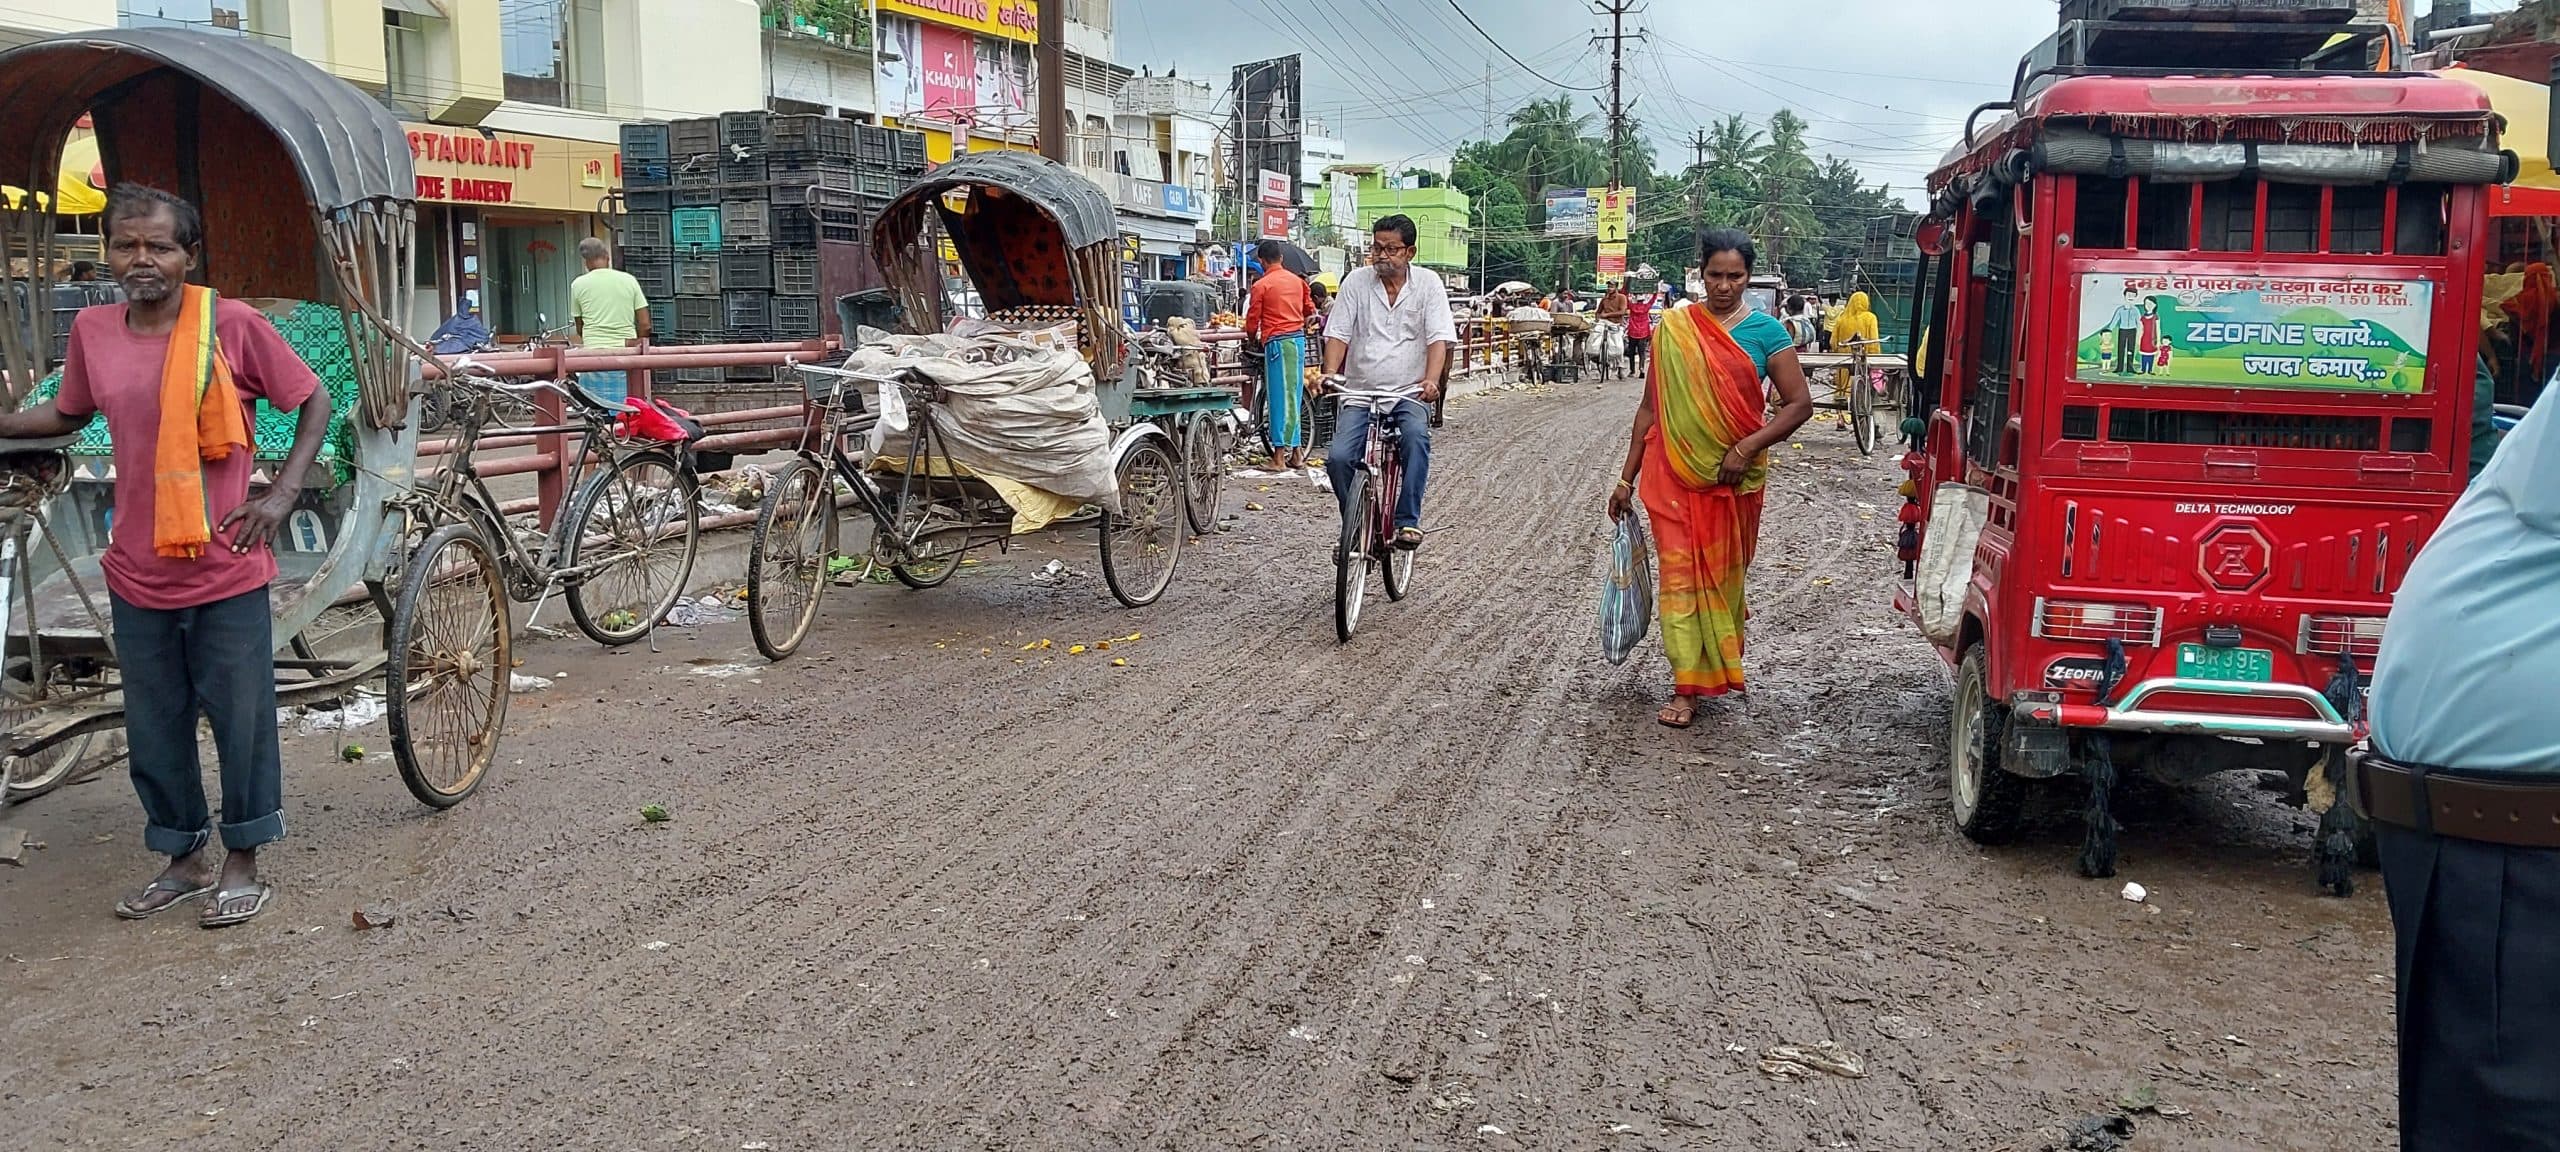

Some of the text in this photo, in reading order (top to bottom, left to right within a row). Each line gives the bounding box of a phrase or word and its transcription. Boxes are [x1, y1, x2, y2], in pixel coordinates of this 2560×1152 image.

[925, 69, 973, 92] KHADIM
[451, 177, 513, 203] BAKERY
[1132, 182, 1153, 206] KAFF
[2197, 279, 2232, 291] पास
[2236, 279, 2266, 291] कर
[2270, 281, 2315, 293] वरना
[2372, 283, 2404, 295] कर
[2339, 295, 2370, 306] 150
[2376, 295, 2413, 306] Km.
[2186, 322, 2305, 344] ZEOFINE
[2243, 356, 2304, 376] ज्यादा
[2175, 503, 2296, 515] DELTA TECHNOLOGY
